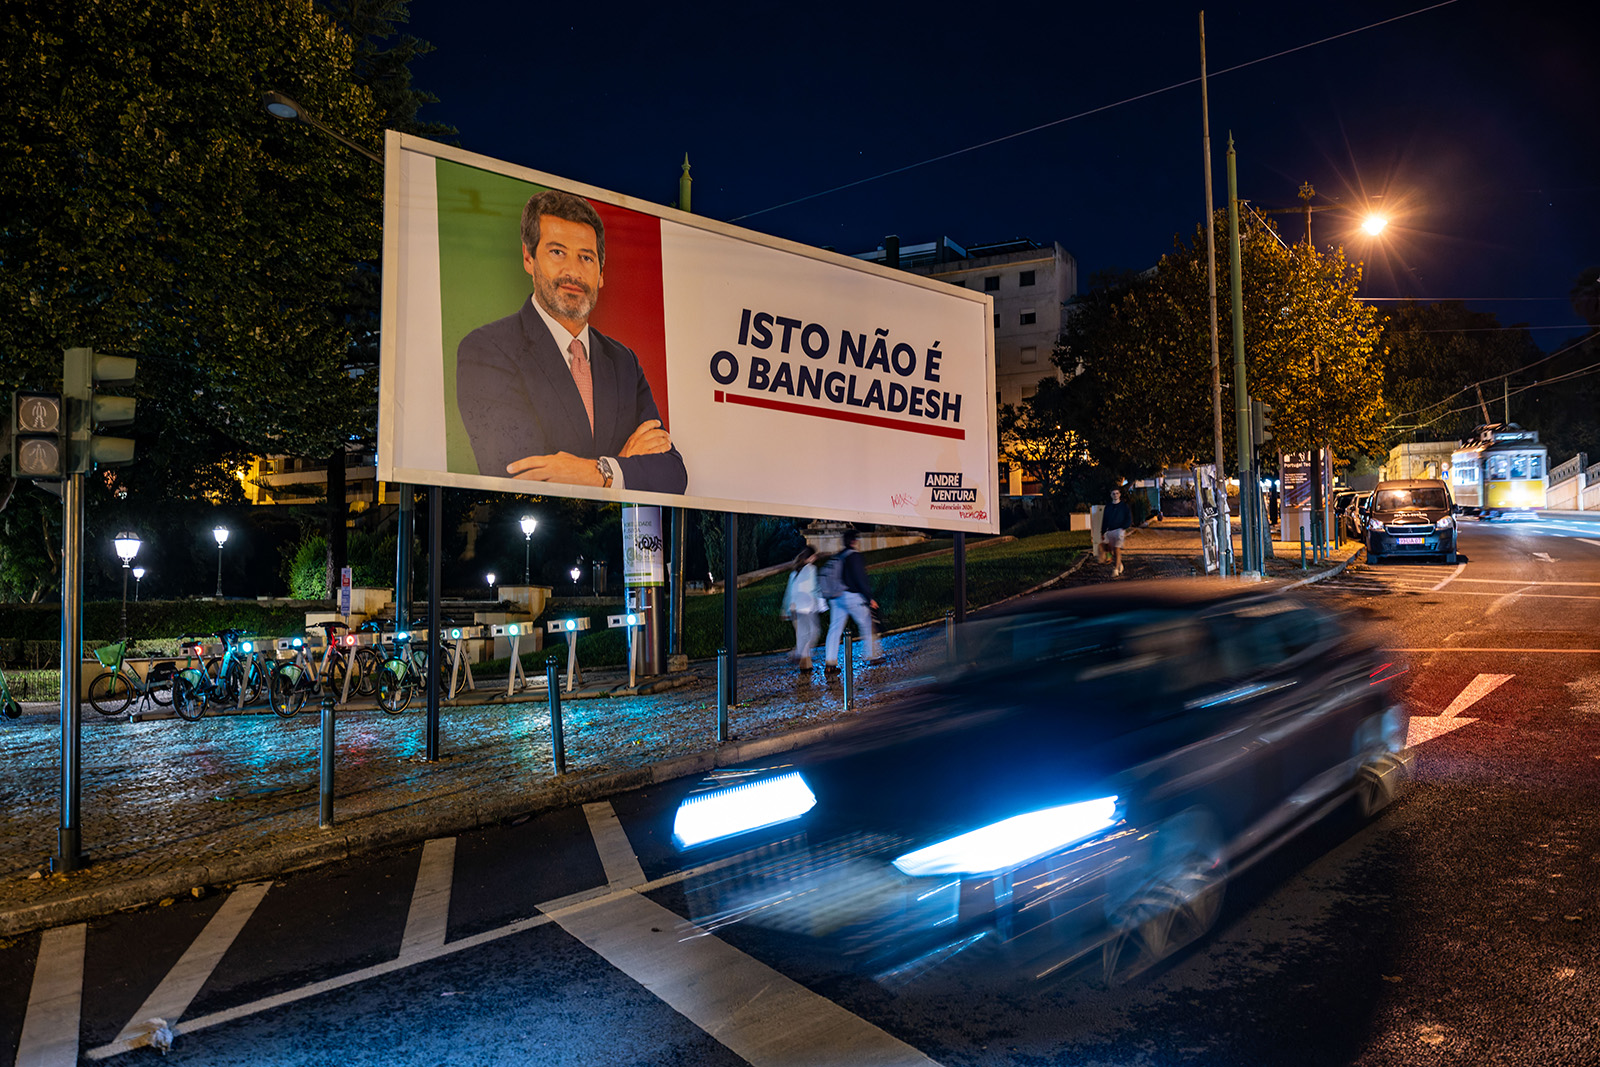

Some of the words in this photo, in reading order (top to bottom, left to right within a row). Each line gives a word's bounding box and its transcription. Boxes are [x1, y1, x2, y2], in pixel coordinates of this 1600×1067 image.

[738, 308, 829, 359] ISTO
[838, 328, 917, 377] NÃO
[924, 340, 942, 383] É
[709, 350, 739, 385] O
[748, 356, 962, 423] BANGLADESH
[926, 473, 960, 486] ANDRÉ
[933, 489, 975, 501] VENTURA
